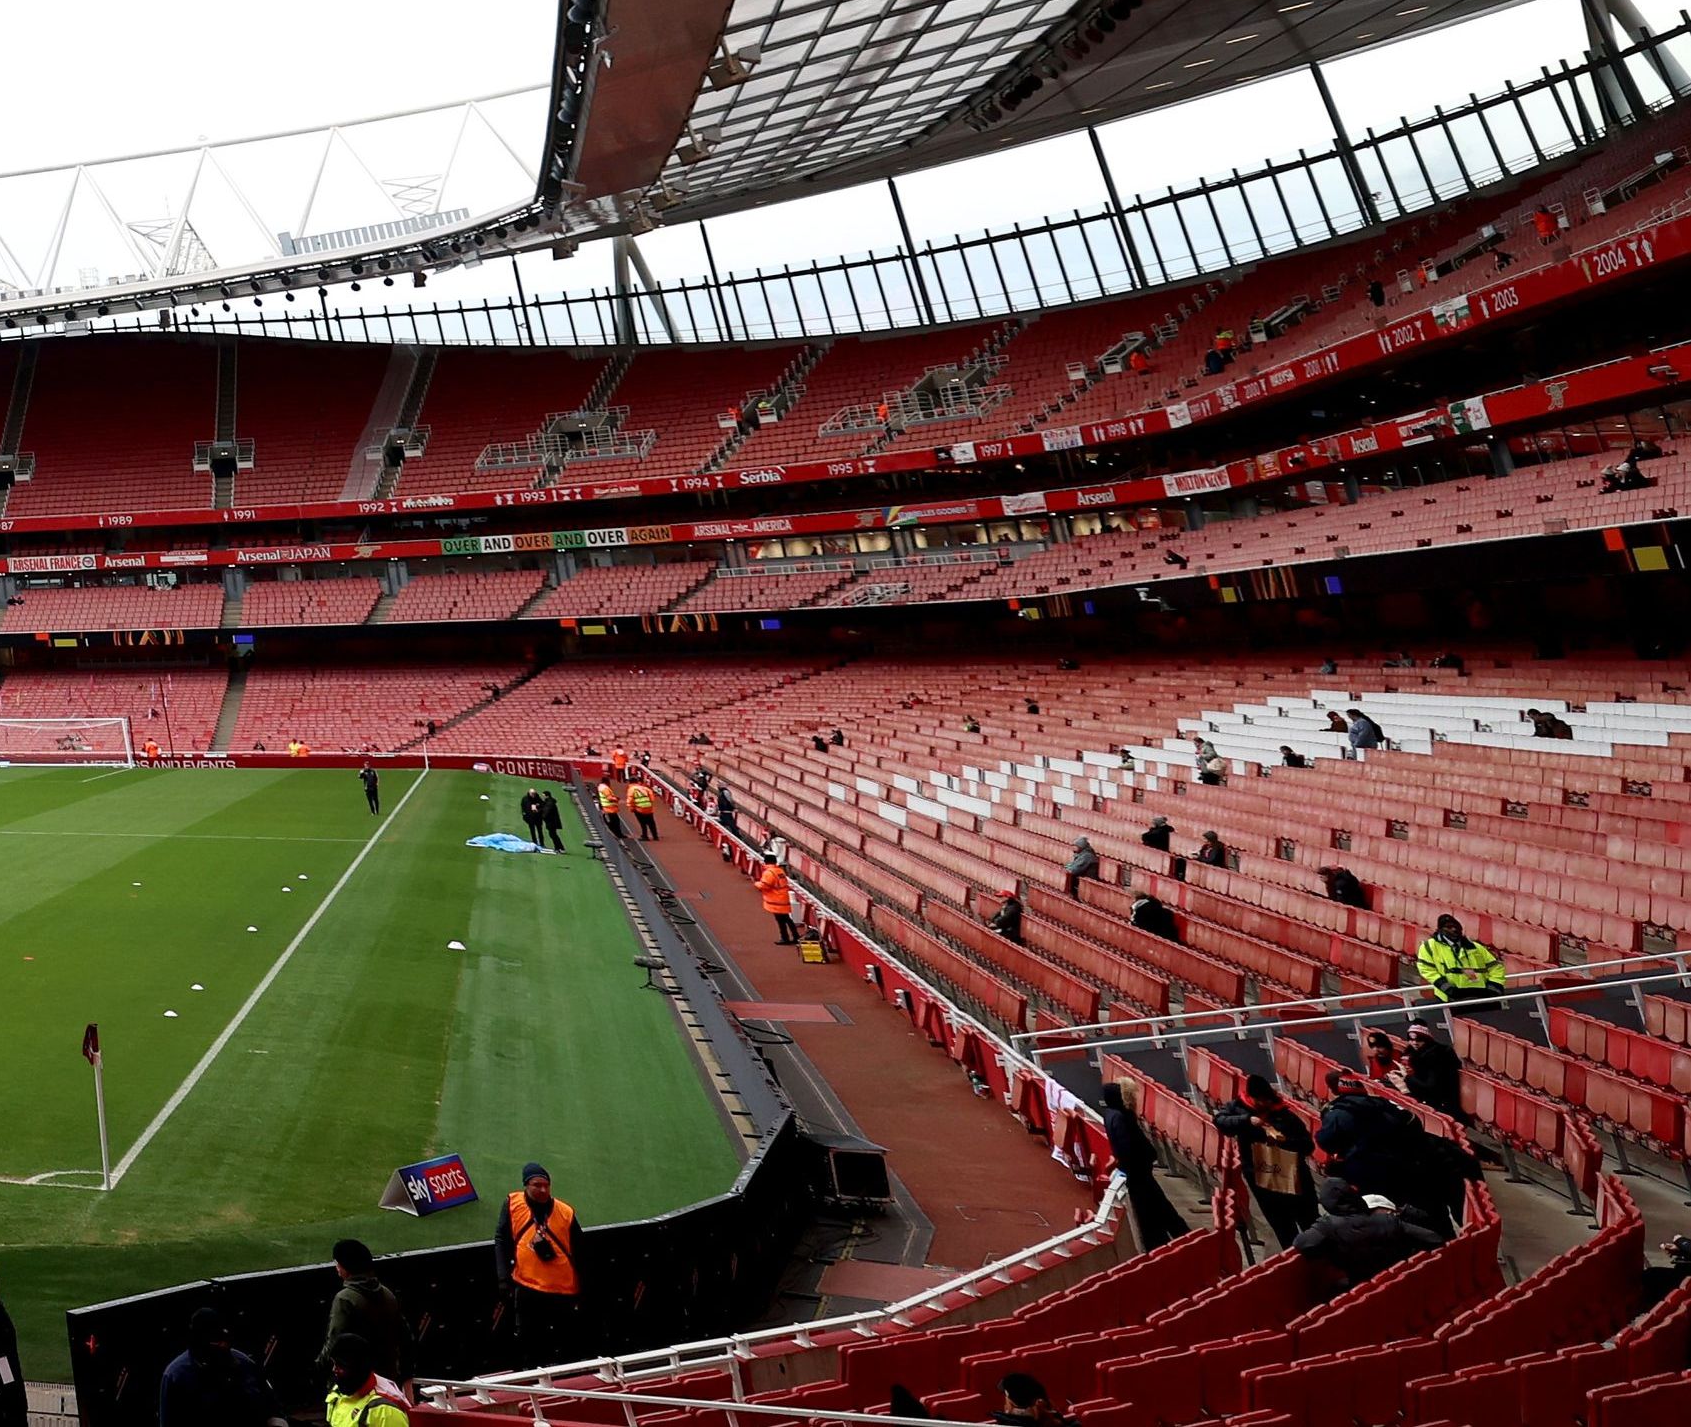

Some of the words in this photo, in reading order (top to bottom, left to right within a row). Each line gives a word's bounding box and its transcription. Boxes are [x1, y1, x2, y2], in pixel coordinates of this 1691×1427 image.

[1594, 250, 1627, 277] 2004
[1491, 287, 1519, 312] 2003
[1392, 324, 1415, 347] 2002
[981, 443, 1003, 457] 1997
[1350, 431, 1377, 454] Arsenal
[828, 462, 853, 475] 1995
[683, 477, 710, 489] 1994
[739, 469, 782, 485] Serbia
[520, 492, 546, 503] 1993
[1076, 490, 1116, 506] Arsenal
[233, 510, 256, 520] 1991
[358, 502, 385, 513] 1992
[108, 516, 133, 525] 1989
[694, 523, 732, 538] ARSENAL
[753, 519, 792, 534] AMERICA
[443, 539, 479, 553] OVER
[484, 537, 511, 550] AND
[515, 534, 551, 548] OVER
[555, 532, 583, 546] AND
[587, 530, 625, 544] OVER
[630, 527, 671, 542] AGAIN
[104, 556, 145, 568] Arsenal
[237, 549, 281, 562] Arsenal
[290, 547, 331, 559] JAPAN
[12, 557, 48, 571] ARSENAL
[50, 555, 81, 569] FRANCE
[153, 760, 178, 768] AND
[184, 760, 236, 769] EVENTS
[407, 1174, 432, 1204] sky
[429, 1168, 467, 1197] sports
